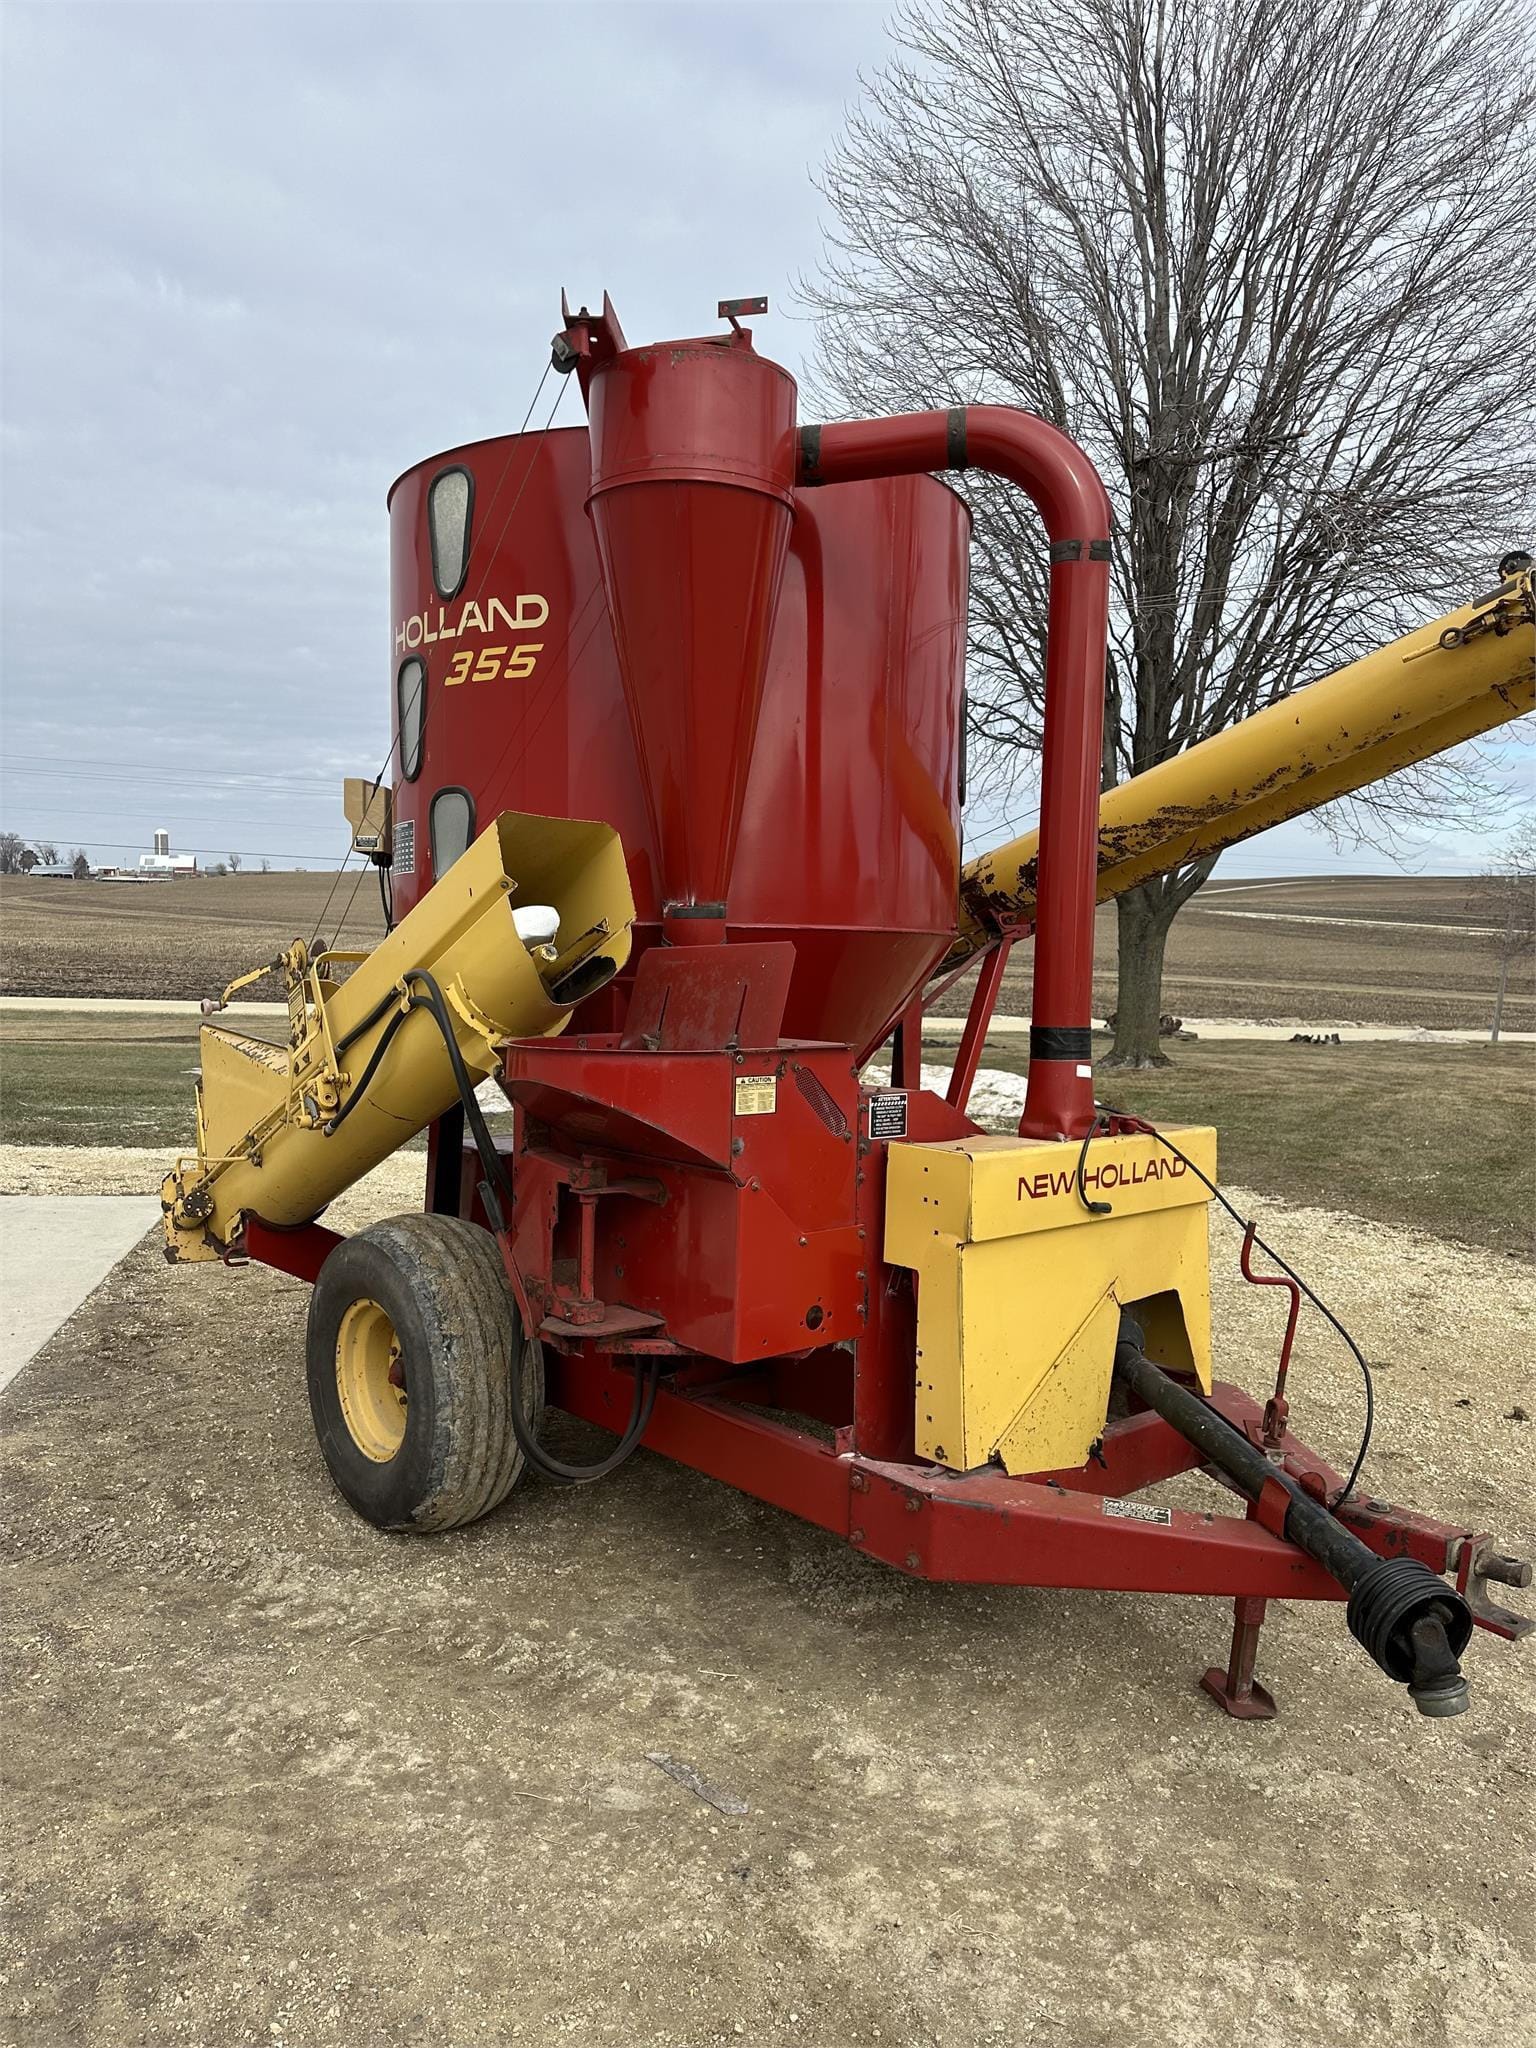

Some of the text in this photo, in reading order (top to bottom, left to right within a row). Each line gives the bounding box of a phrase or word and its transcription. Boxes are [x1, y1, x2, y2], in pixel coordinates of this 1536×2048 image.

[395, 594, 549, 656] HOLLAND
[444, 643, 544, 687] 355
[1017, 1156, 1187, 1201] NEW HOLLAND
